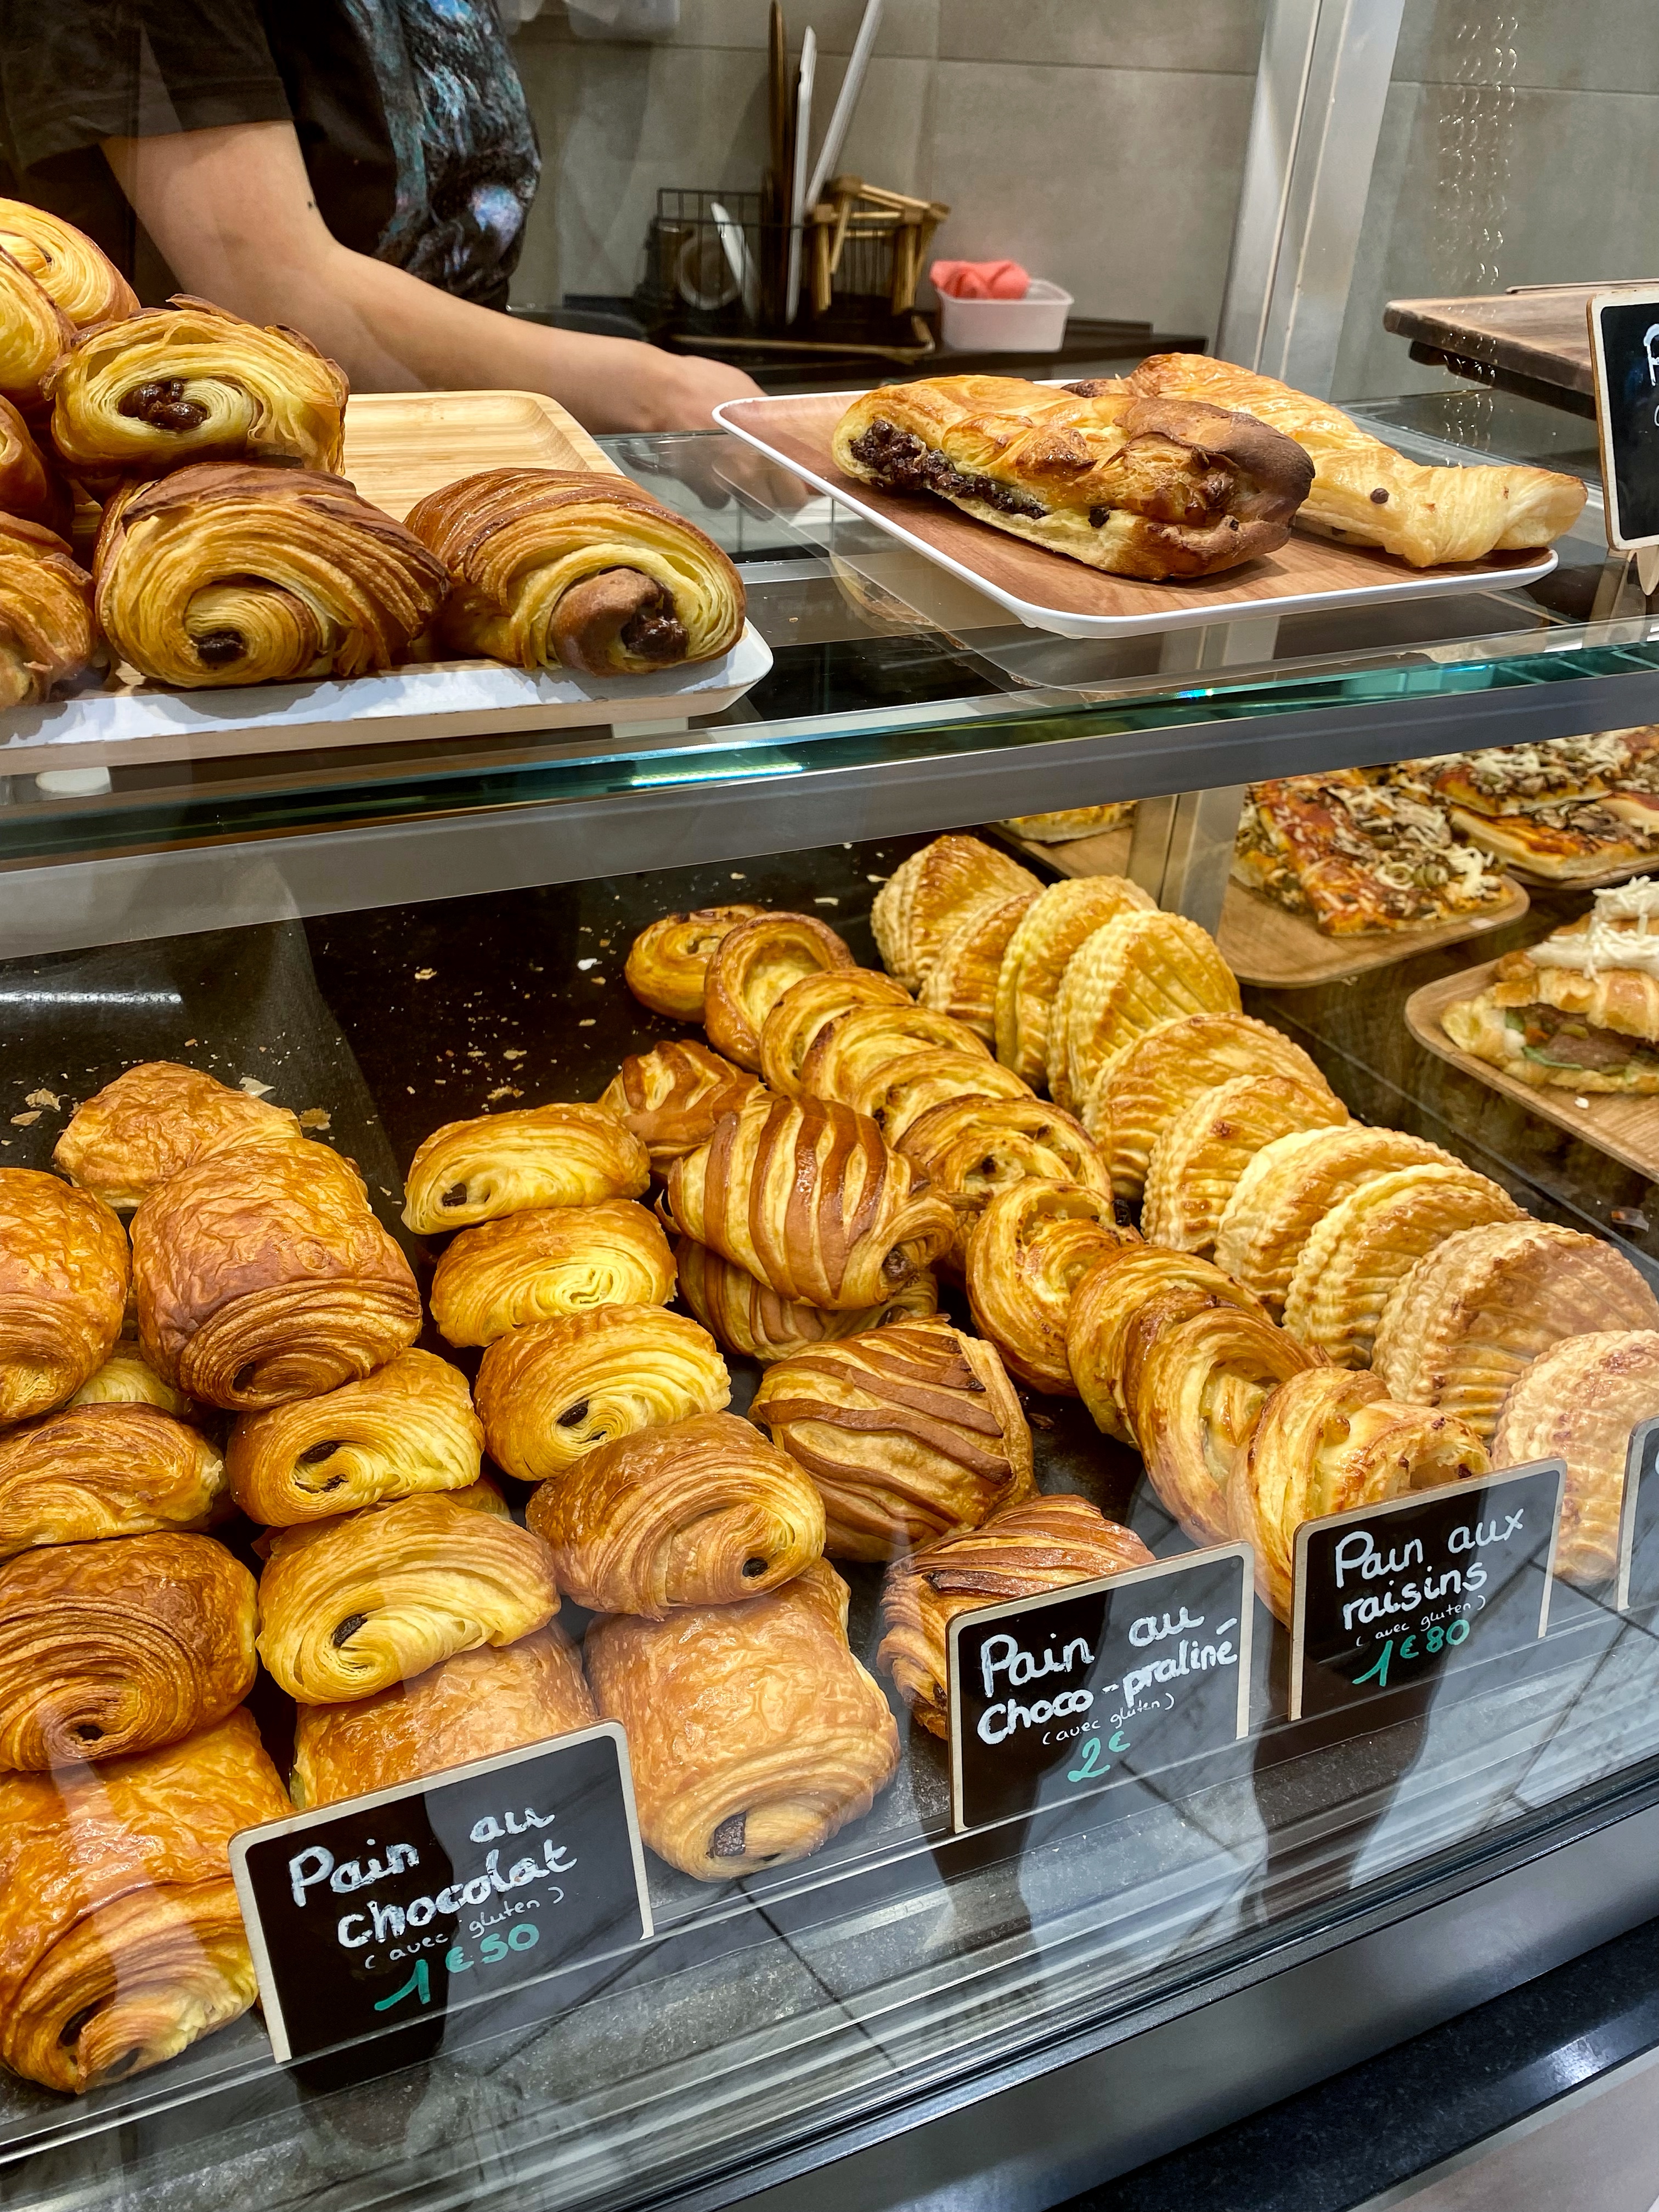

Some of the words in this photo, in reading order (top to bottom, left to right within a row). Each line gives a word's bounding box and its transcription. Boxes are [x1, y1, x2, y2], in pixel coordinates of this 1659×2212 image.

[1335, 1531, 1423, 1588] Pain
[1448, 1508, 1524, 1553] aux
[1342, 1562, 1488, 1630] raisins
[980, 1633, 1095, 1697] Pain
[1128, 1606, 1204, 1647] au
[289, 1838, 420, 1907] Pain
[470, 1808, 555, 1843] au
[338, 1839, 577, 1948] chocolat
